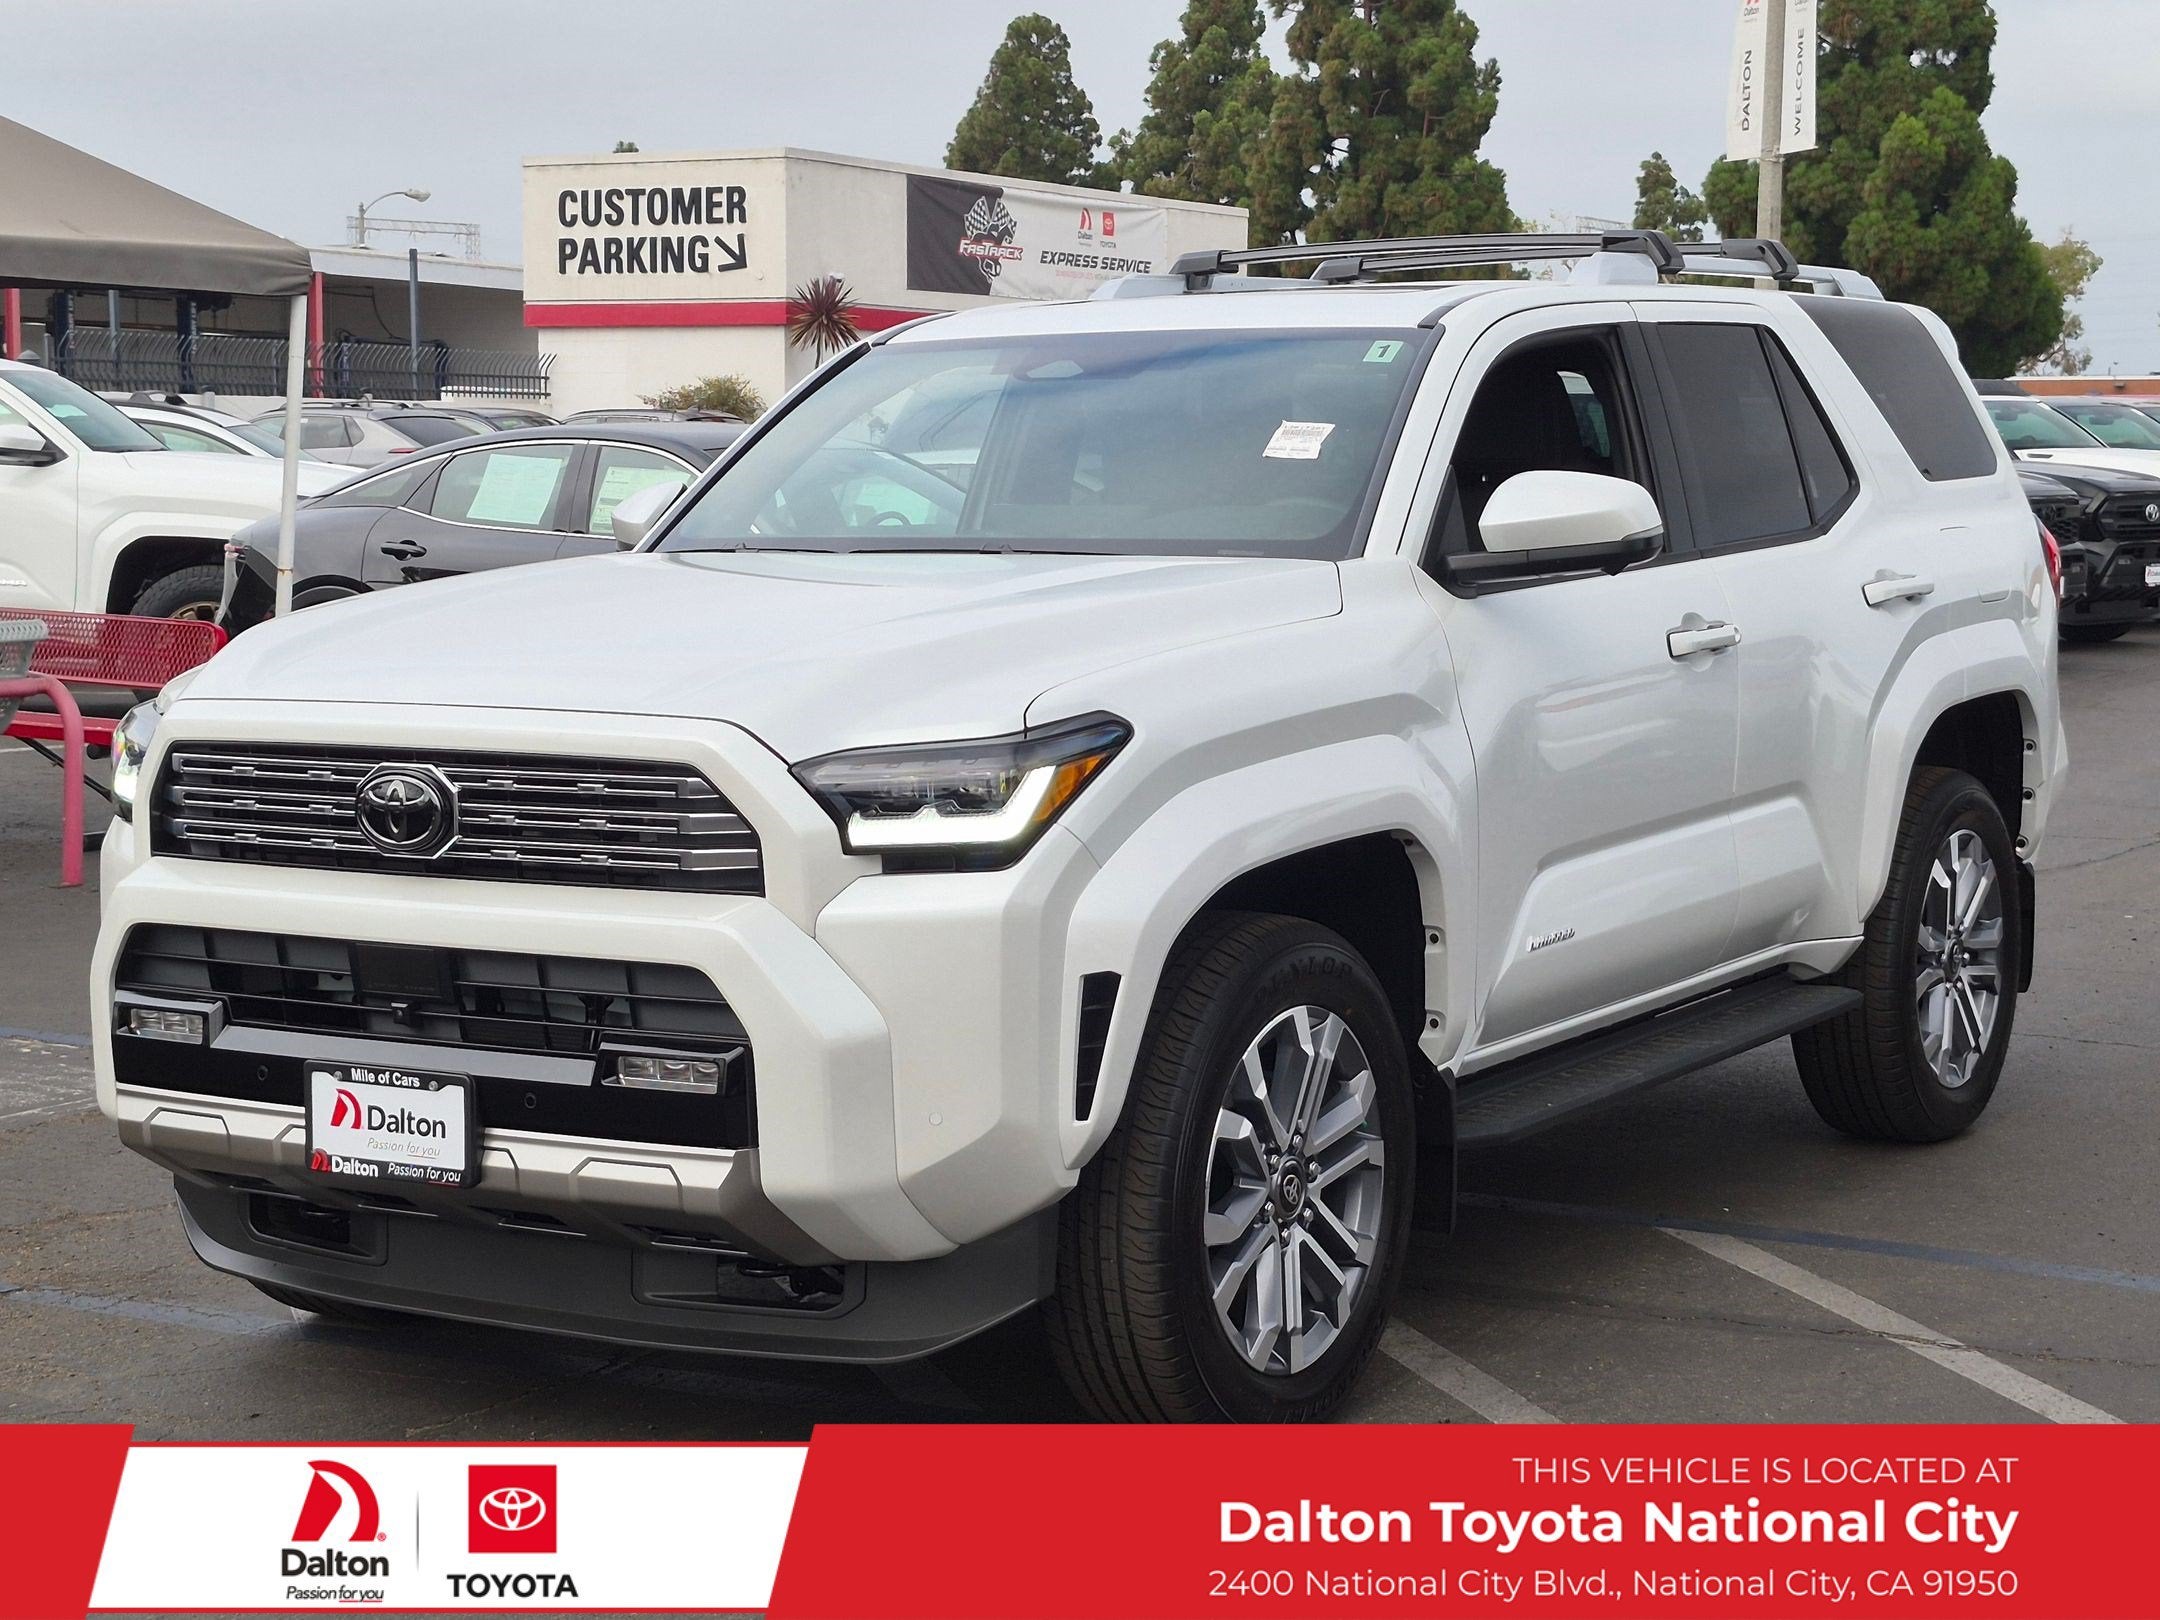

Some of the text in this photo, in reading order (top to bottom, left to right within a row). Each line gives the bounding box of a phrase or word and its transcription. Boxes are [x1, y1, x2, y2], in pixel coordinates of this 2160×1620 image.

[1741, 49, 1752, 131] DALTON
[1793, 28, 1805, 136] WELCOME
[558, 185, 747, 228] CUSTOMER
[558, 234, 710, 275] PARKING
[1040, 250, 1152, 274] EXPRESS SERVICE
[1376, 344, 1391, 358] 1
[351, 1068, 420, 1088] Mile of Cars
[367, 1104, 446, 1139] Dalton
[367, 1137, 441, 1160] Passion for you
[331, 1155, 379, 1177] Dalton
[387, 1162, 461, 1184] Passion for you
